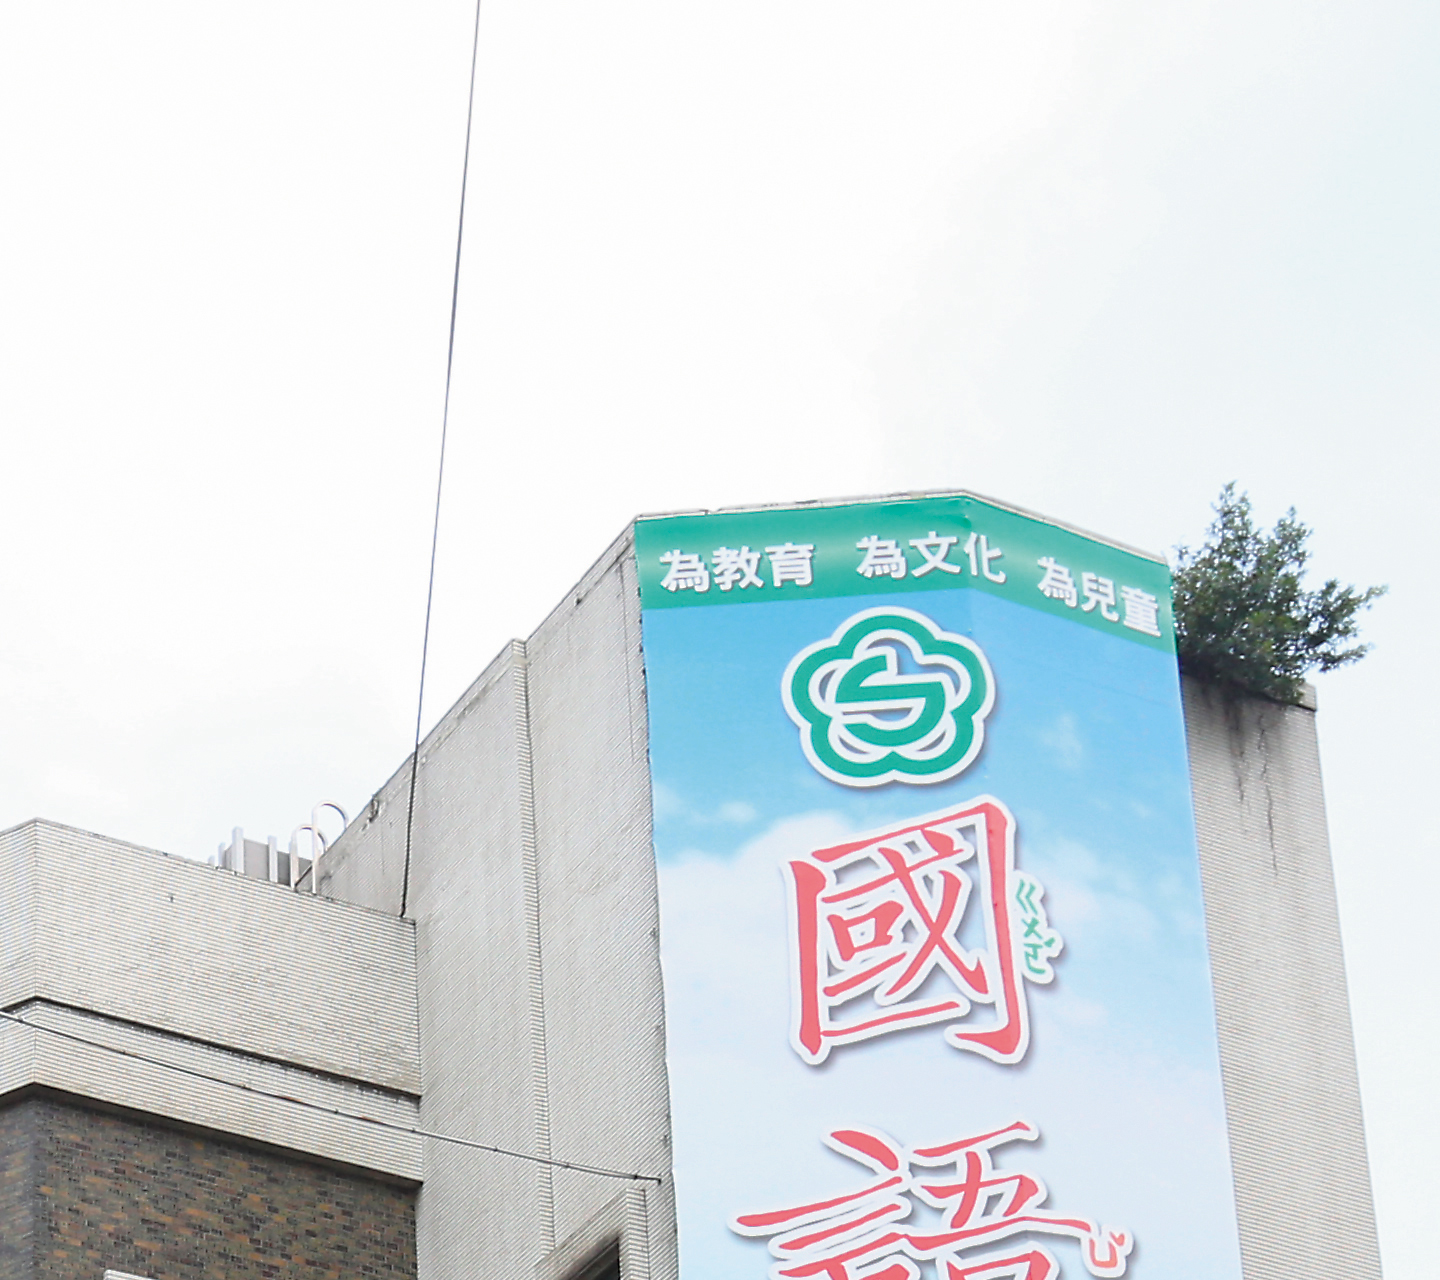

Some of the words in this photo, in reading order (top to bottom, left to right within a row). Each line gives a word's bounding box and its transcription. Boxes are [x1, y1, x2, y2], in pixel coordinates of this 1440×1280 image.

[658, 541, 815, 594] 為教育
[856, 529, 1008, 586] 為文化
[1037, 555, 1162, 639] 為兒童
